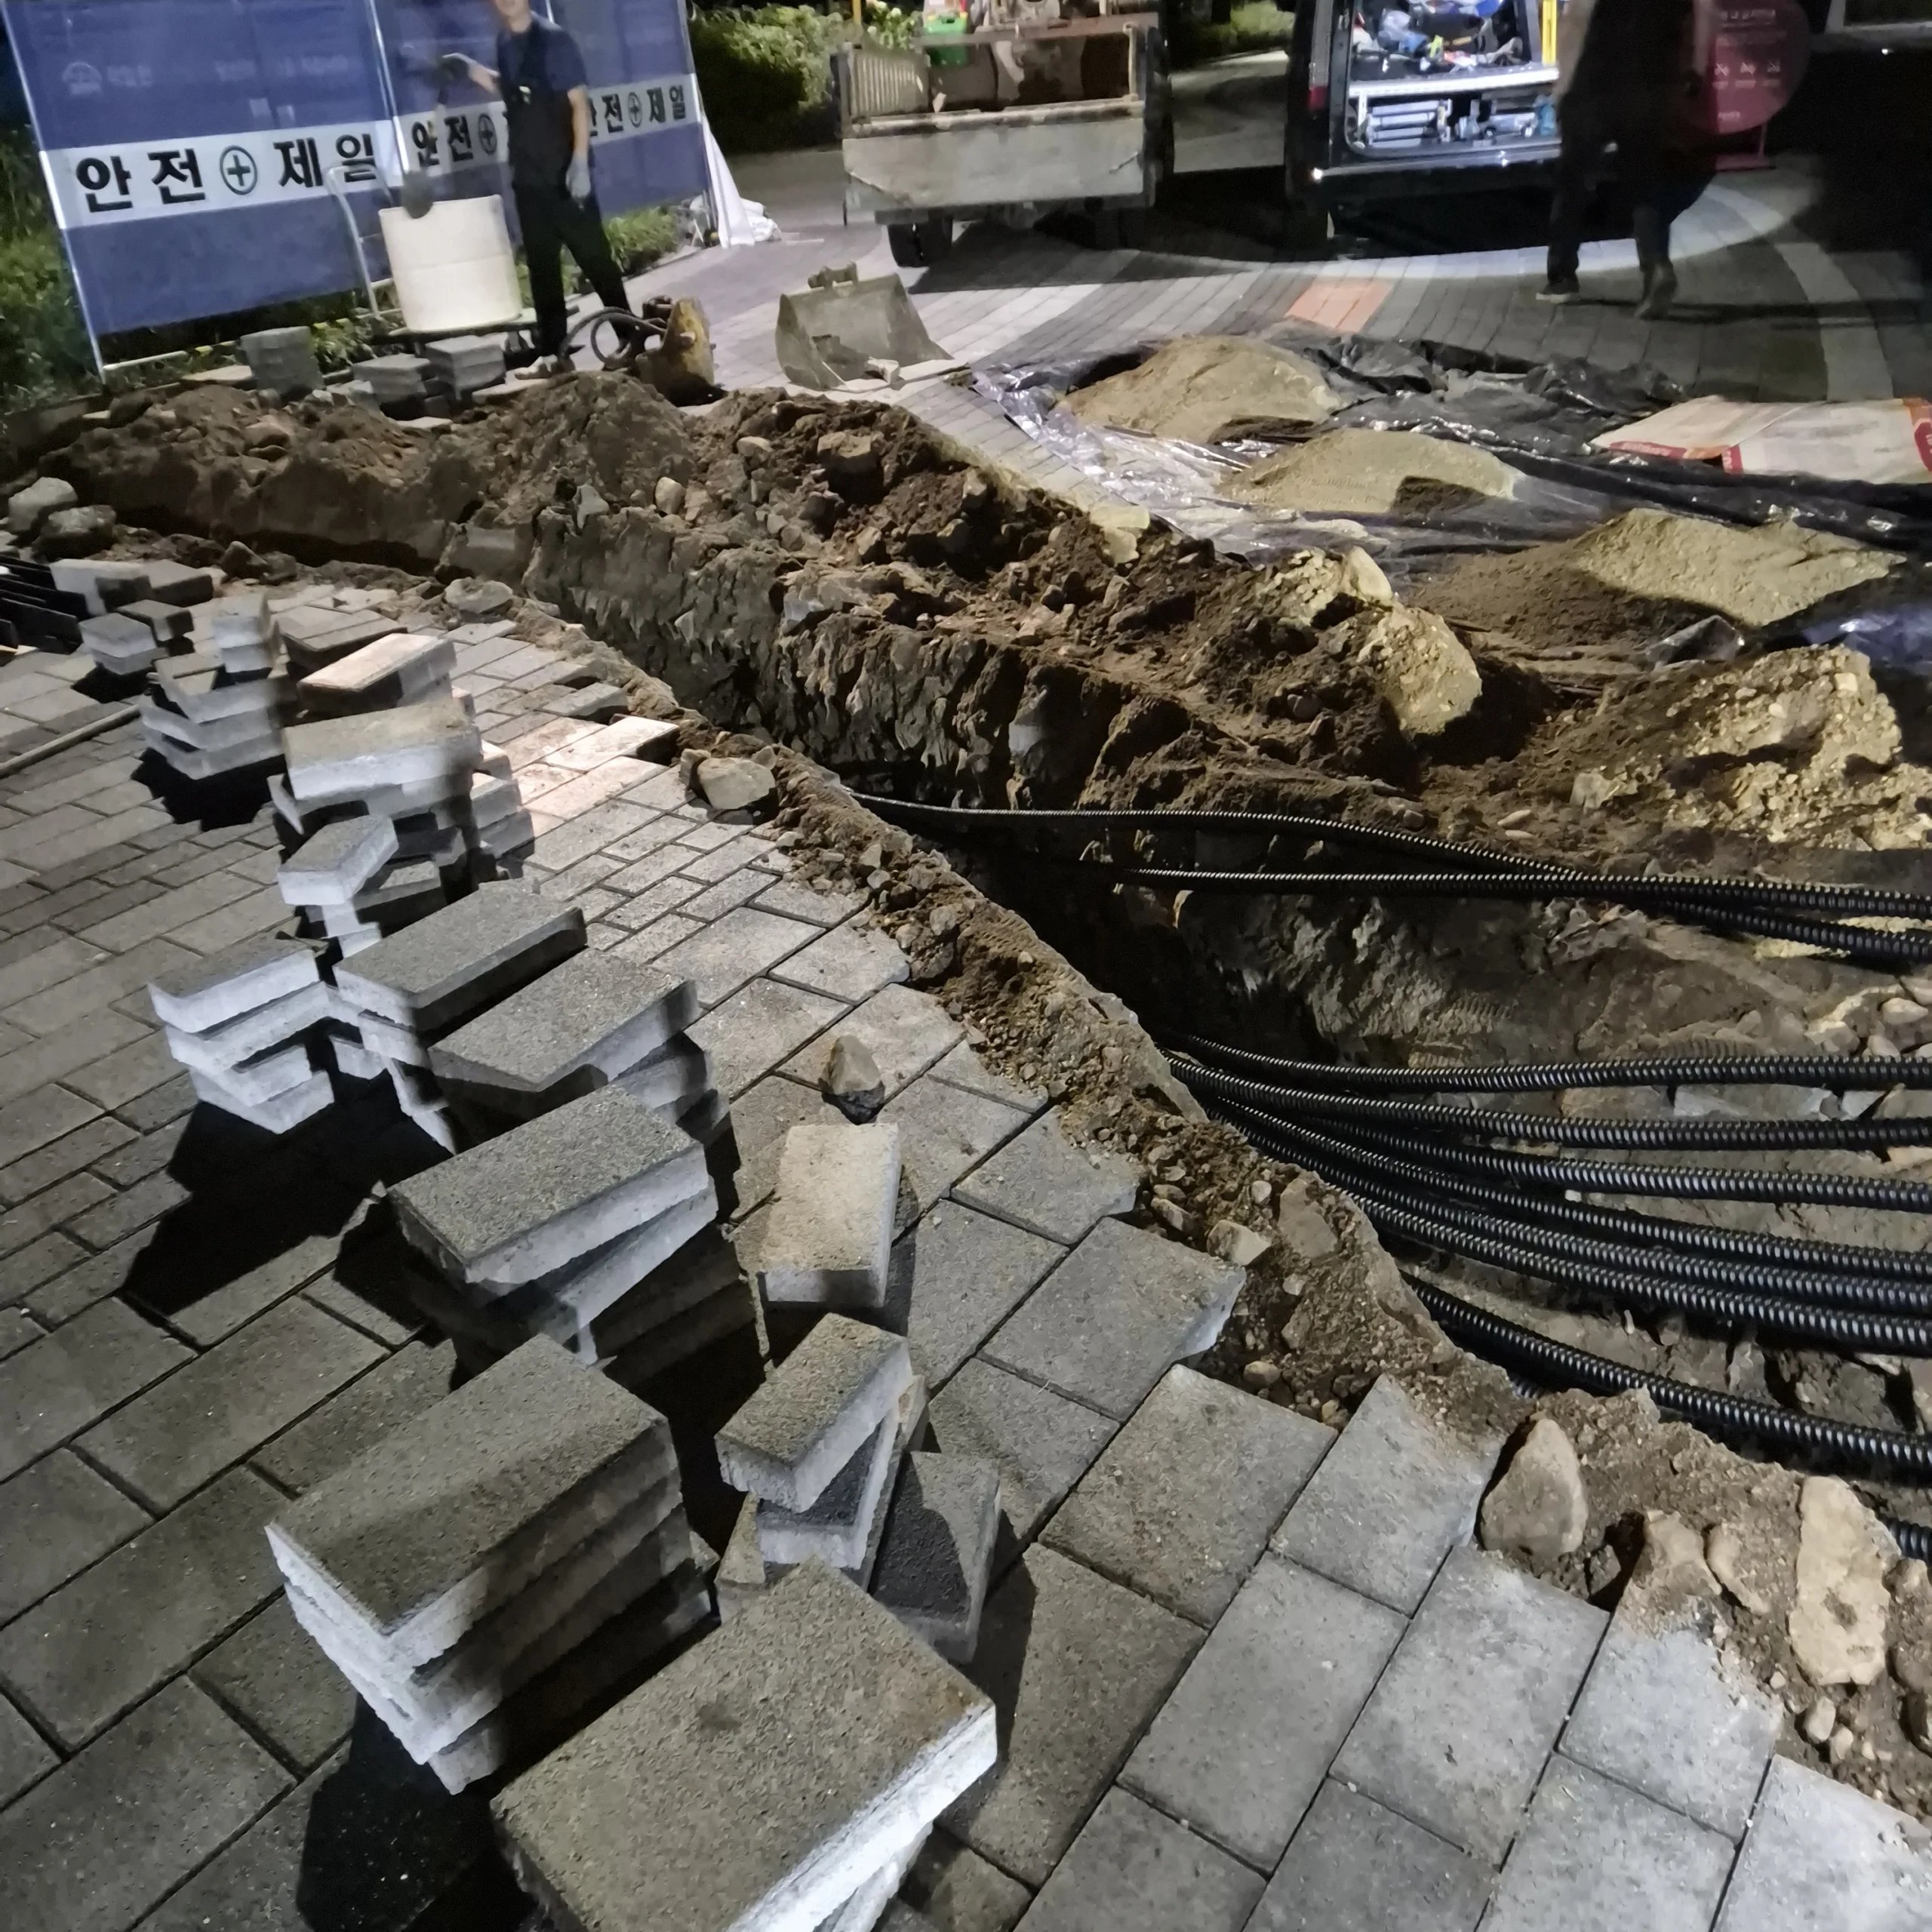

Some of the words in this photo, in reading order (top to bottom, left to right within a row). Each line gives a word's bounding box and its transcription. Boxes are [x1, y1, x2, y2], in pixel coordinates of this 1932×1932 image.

[75, 148, 206, 214] 안전
[272, 133, 377, 188] 제일
[411, 113, 474, 168] 안전
